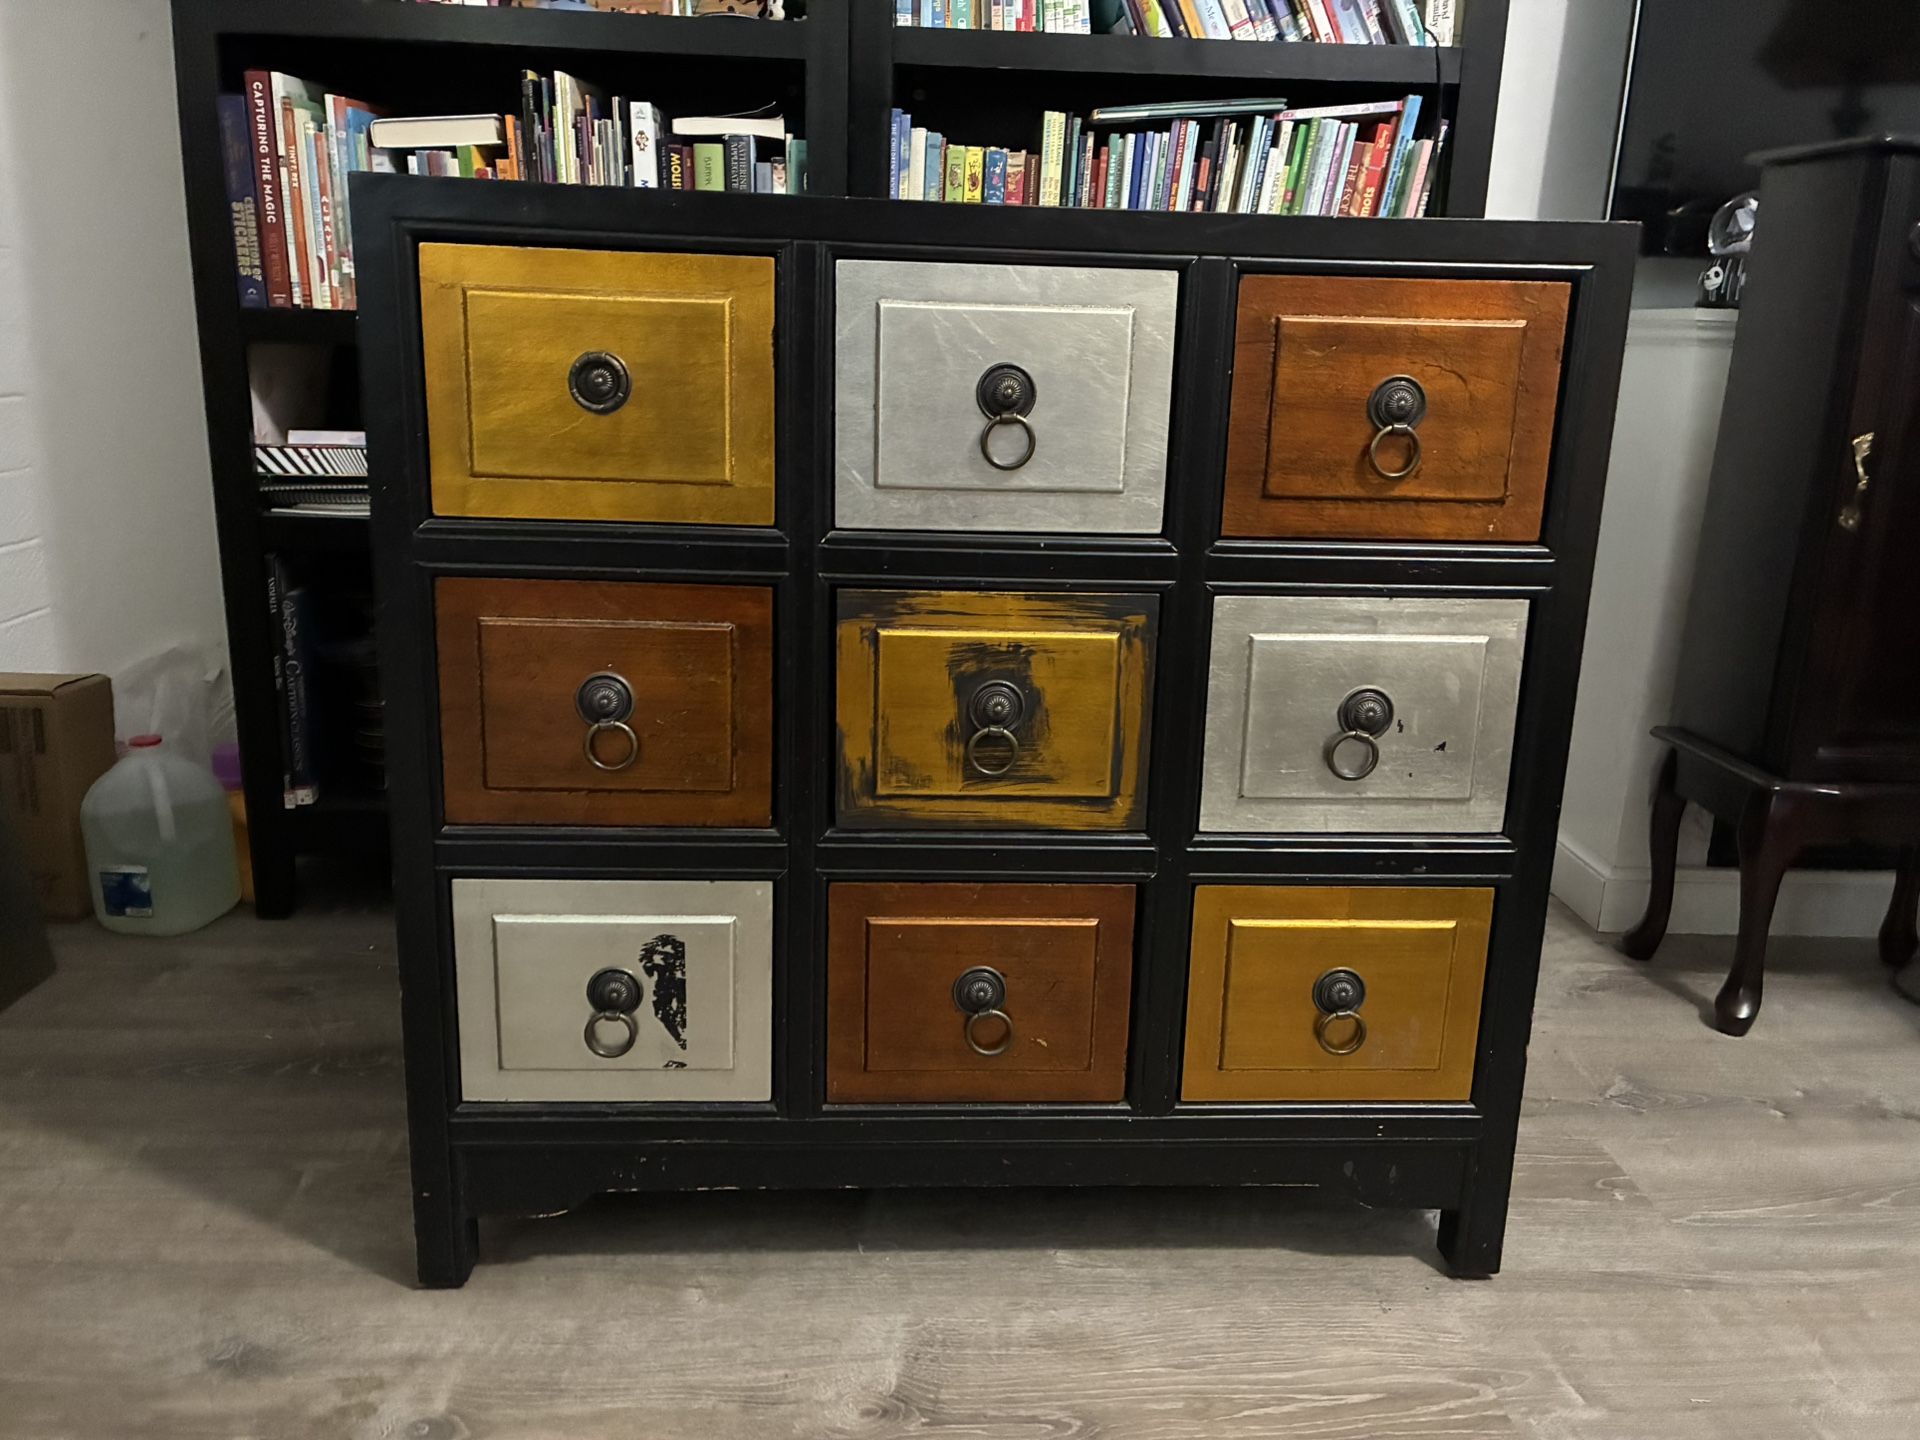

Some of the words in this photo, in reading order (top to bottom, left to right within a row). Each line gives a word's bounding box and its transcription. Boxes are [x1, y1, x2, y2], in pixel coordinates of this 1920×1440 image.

[252, 81, 269, 153] CAPTURING
[259, 157, 271, 181] THE
[730, 142, 739, 189] APPLEGATE
[738, 141, 748, 190] KATHERINE
[1346, 163, 1359, 181] THE
[264, 185, 277, 223] MAGIC
[231, 201, 251, 276] STICKERS
[243, 196, 261, 265] CELEBRATION
